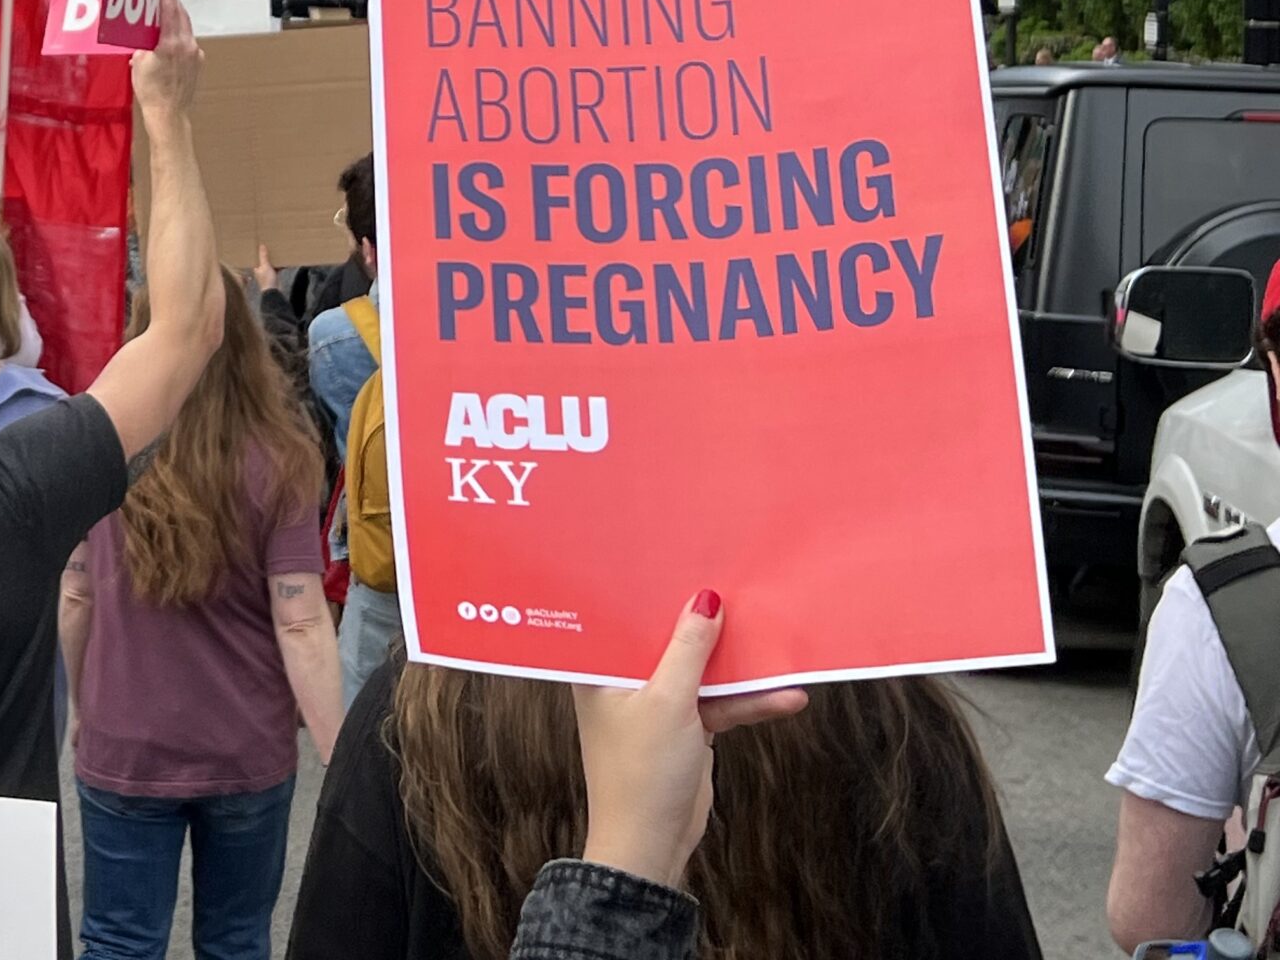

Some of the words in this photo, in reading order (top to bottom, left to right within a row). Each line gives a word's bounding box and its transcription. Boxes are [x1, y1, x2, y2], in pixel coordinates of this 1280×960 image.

[427, 56, 774, 145] ABORTION
[432, 162, 506, 242] IS
[532, 138, 897, 244] FORCING
[437, 234, 944, 347] PREGNANCY
[444, 392, 610, 453] ACLU
[447, 457, 539, 506] KY
